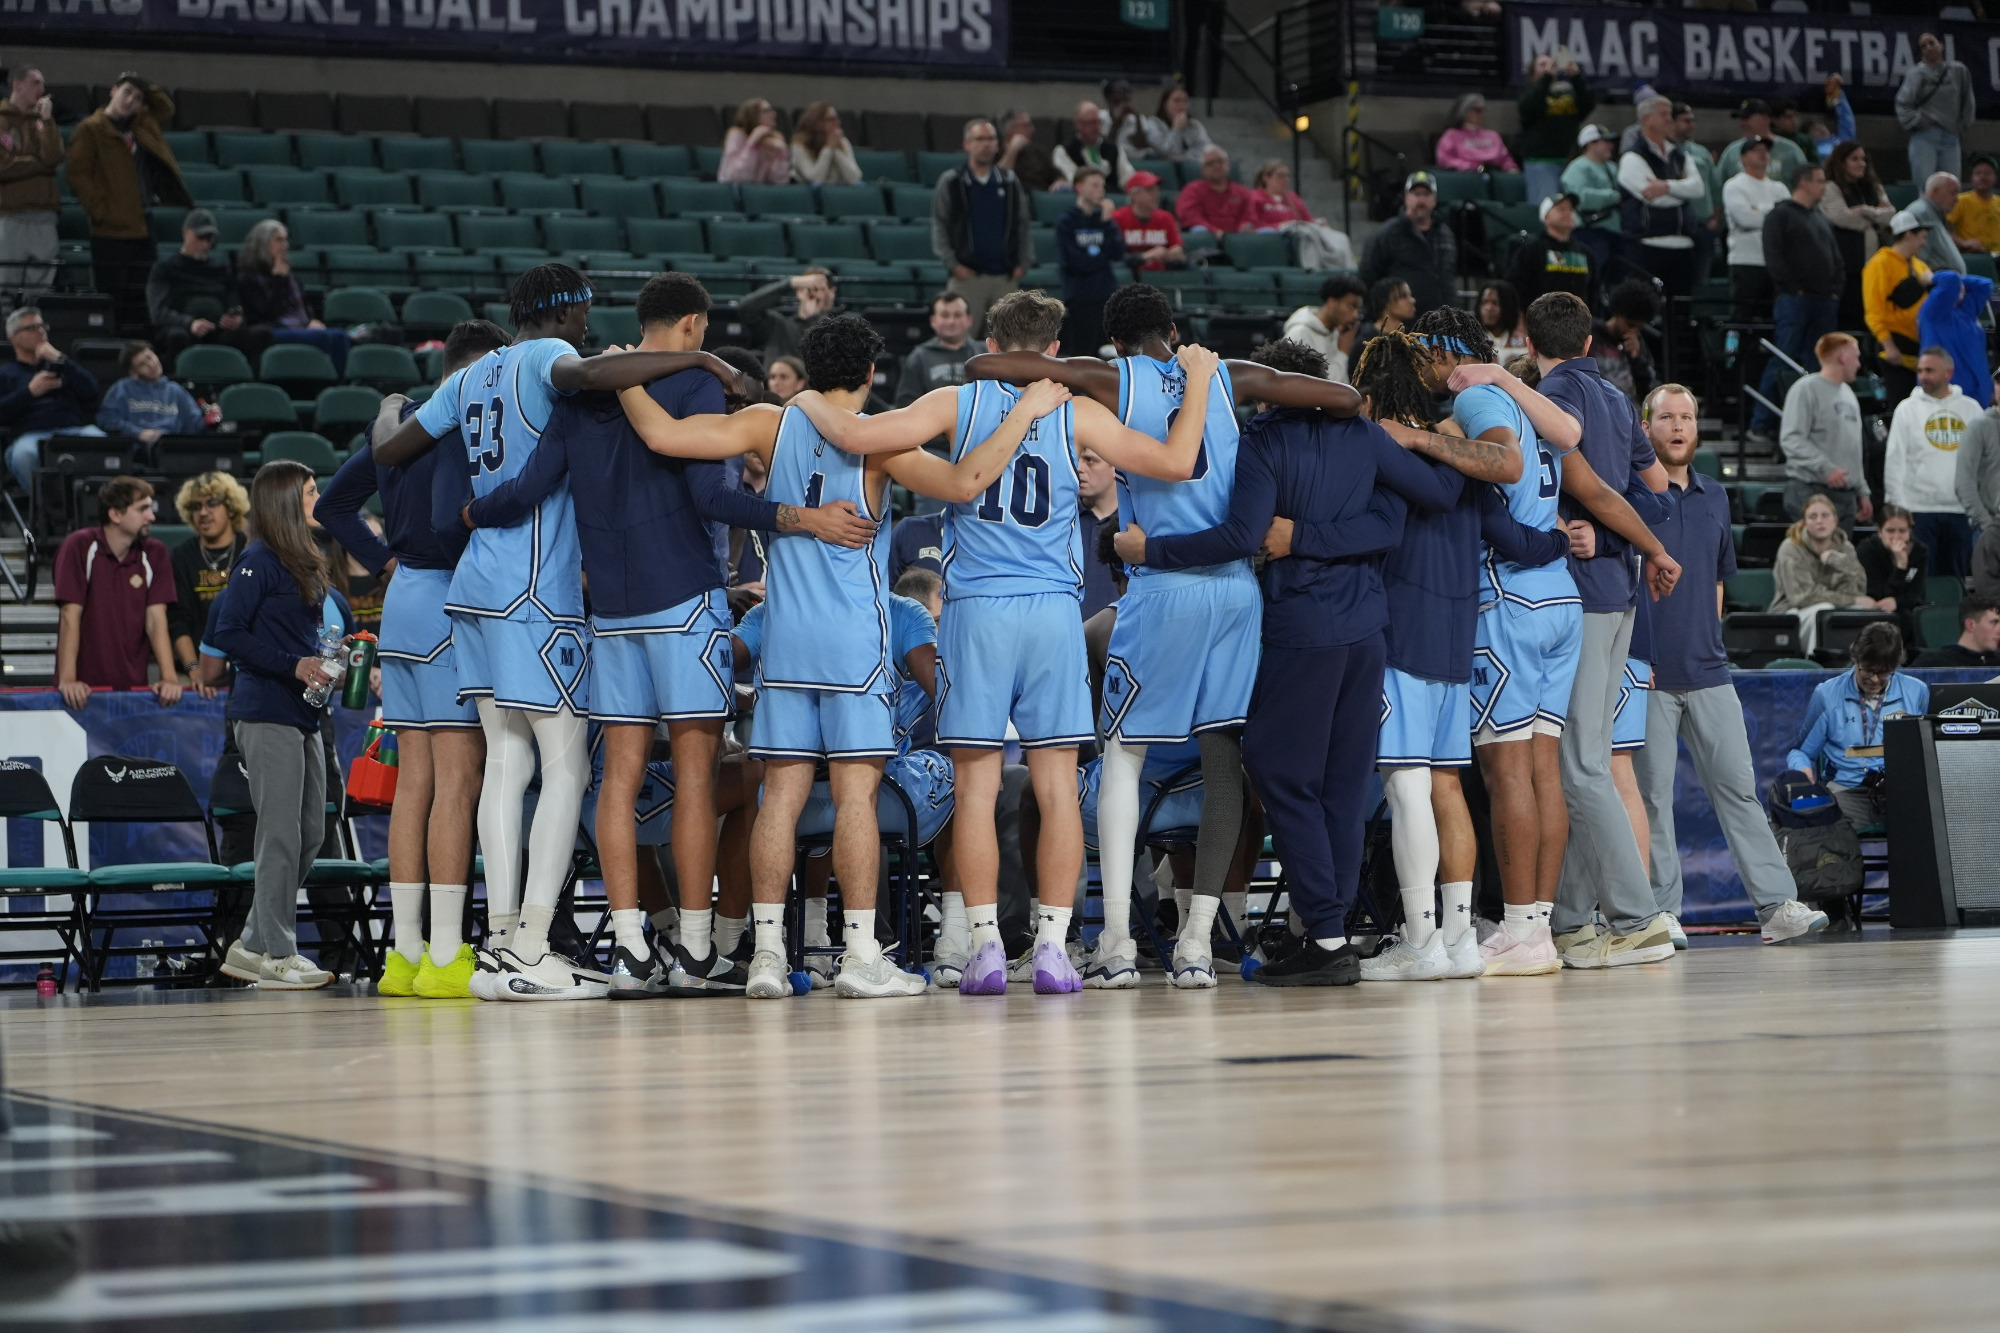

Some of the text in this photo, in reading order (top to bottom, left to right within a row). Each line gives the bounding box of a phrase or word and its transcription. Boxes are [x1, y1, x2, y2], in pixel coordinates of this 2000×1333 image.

[1128, 1, 1155, 19] 121
[564, 0, 993, 51] CHAMPIONSHIPS
[1392, 12, 1421, 31] 120
[1519, 16, 1659, 78] MAAC
[1682, 22, 1956, 88] BASKETBA
[465, 394, 506, 478] 23
[977, 452, 1051, 529] 10
[349, 650, 364, 667] G
[559, 647, 575, 666] M
[719, 648, 731, 669] M
[1108, 675, 1121, 695] M
[1473, 667, 1489, 686] M
